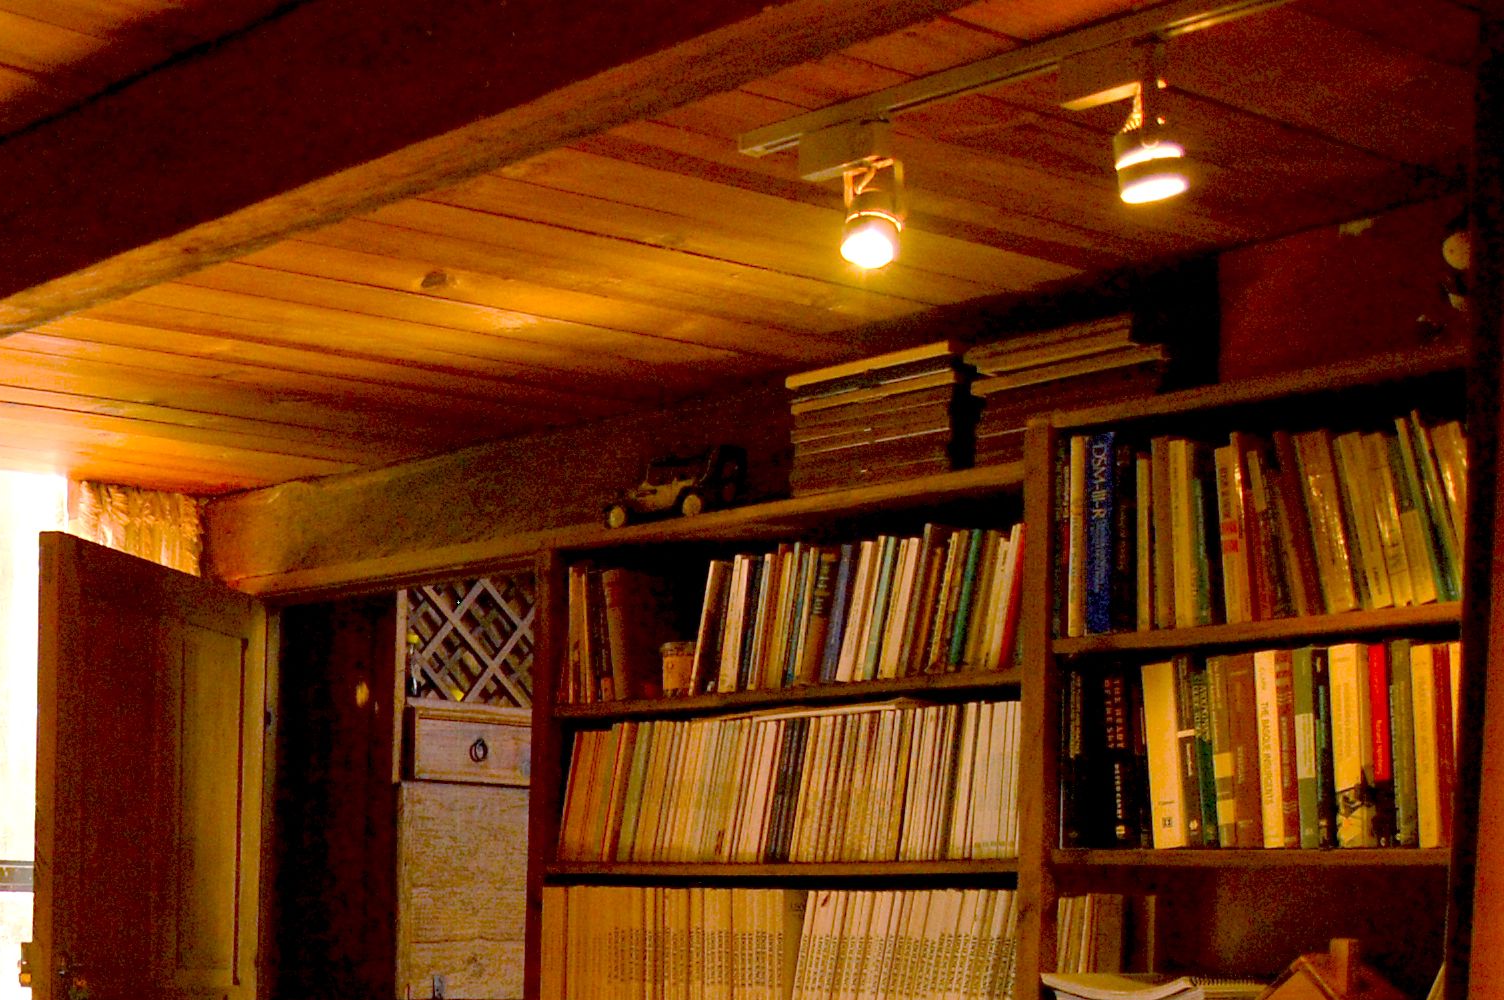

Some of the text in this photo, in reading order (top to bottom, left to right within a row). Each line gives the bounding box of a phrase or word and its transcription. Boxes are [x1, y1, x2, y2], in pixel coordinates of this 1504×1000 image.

[1091, 443, 1108, 520] DSM-III-R
[1261, 702, 1274, 805] THE BASQUE INSURGENTS
